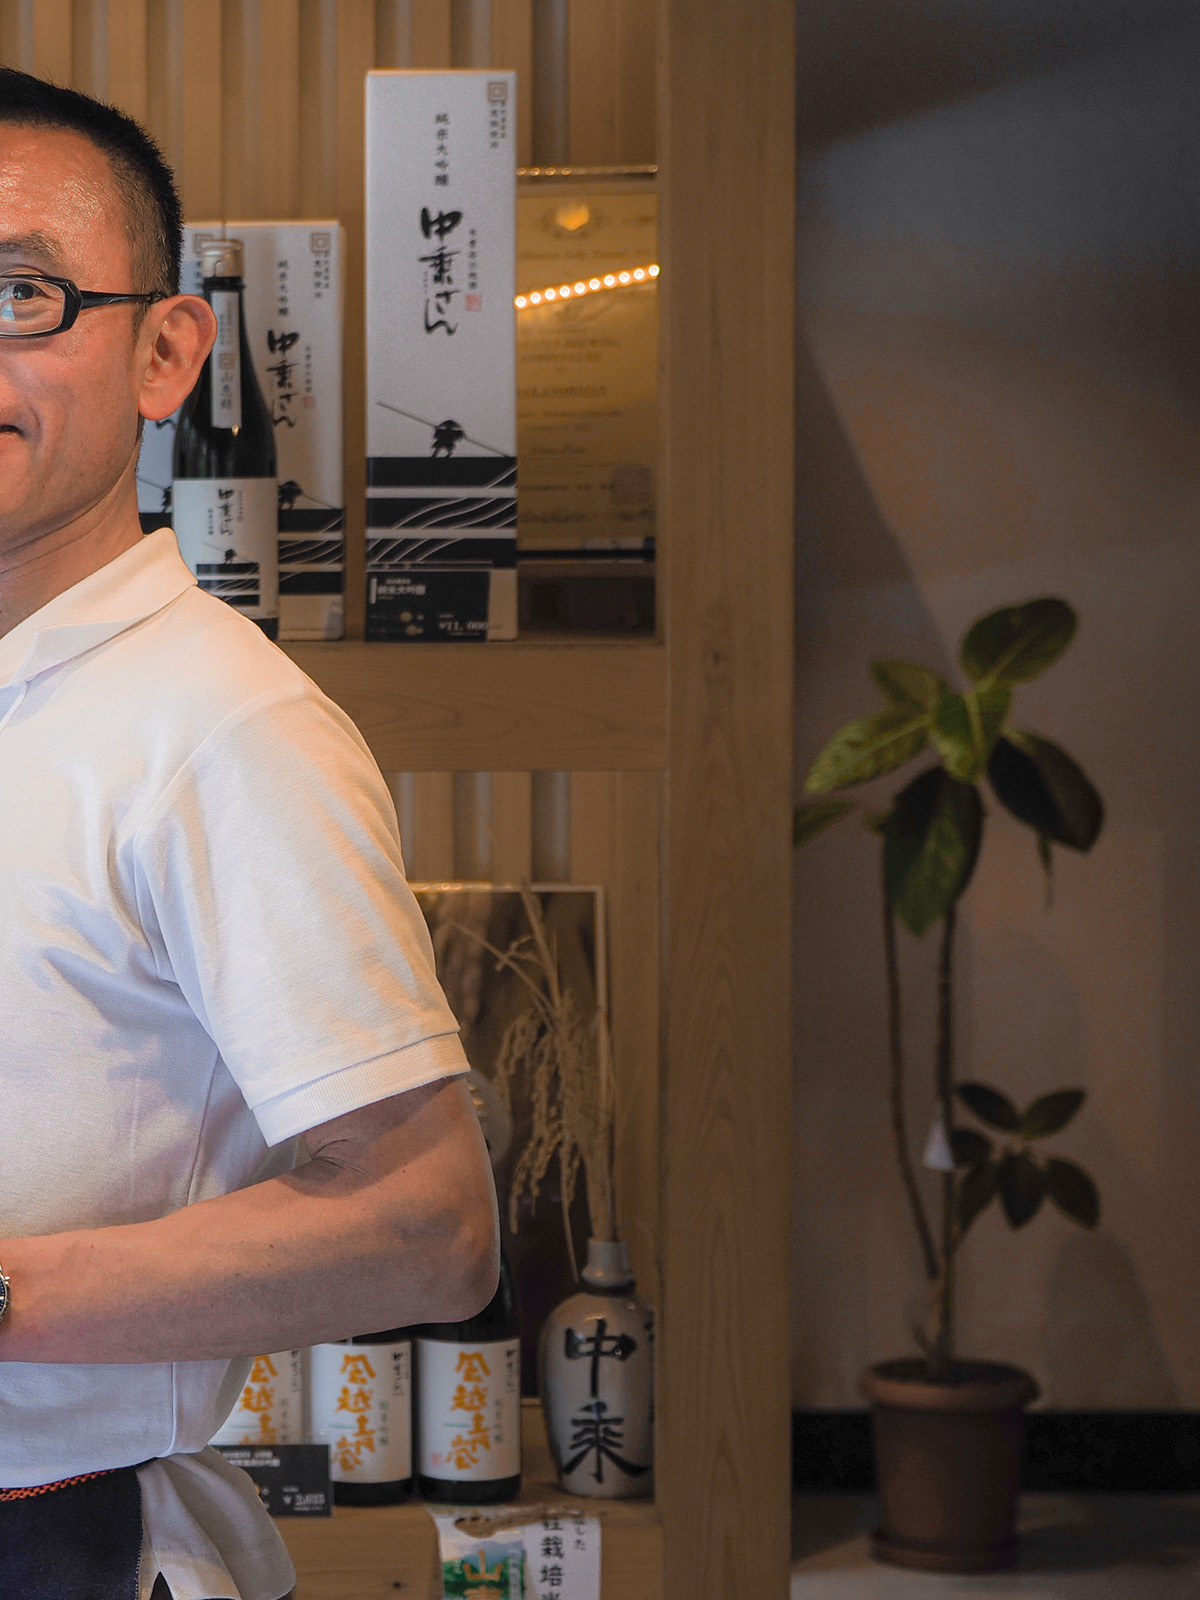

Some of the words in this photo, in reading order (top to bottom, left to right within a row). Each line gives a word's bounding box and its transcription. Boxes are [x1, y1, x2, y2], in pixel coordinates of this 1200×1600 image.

[434, 112, 450, 187] 純米大吟醸
[418, 206, 463, 336] 中乗さん
